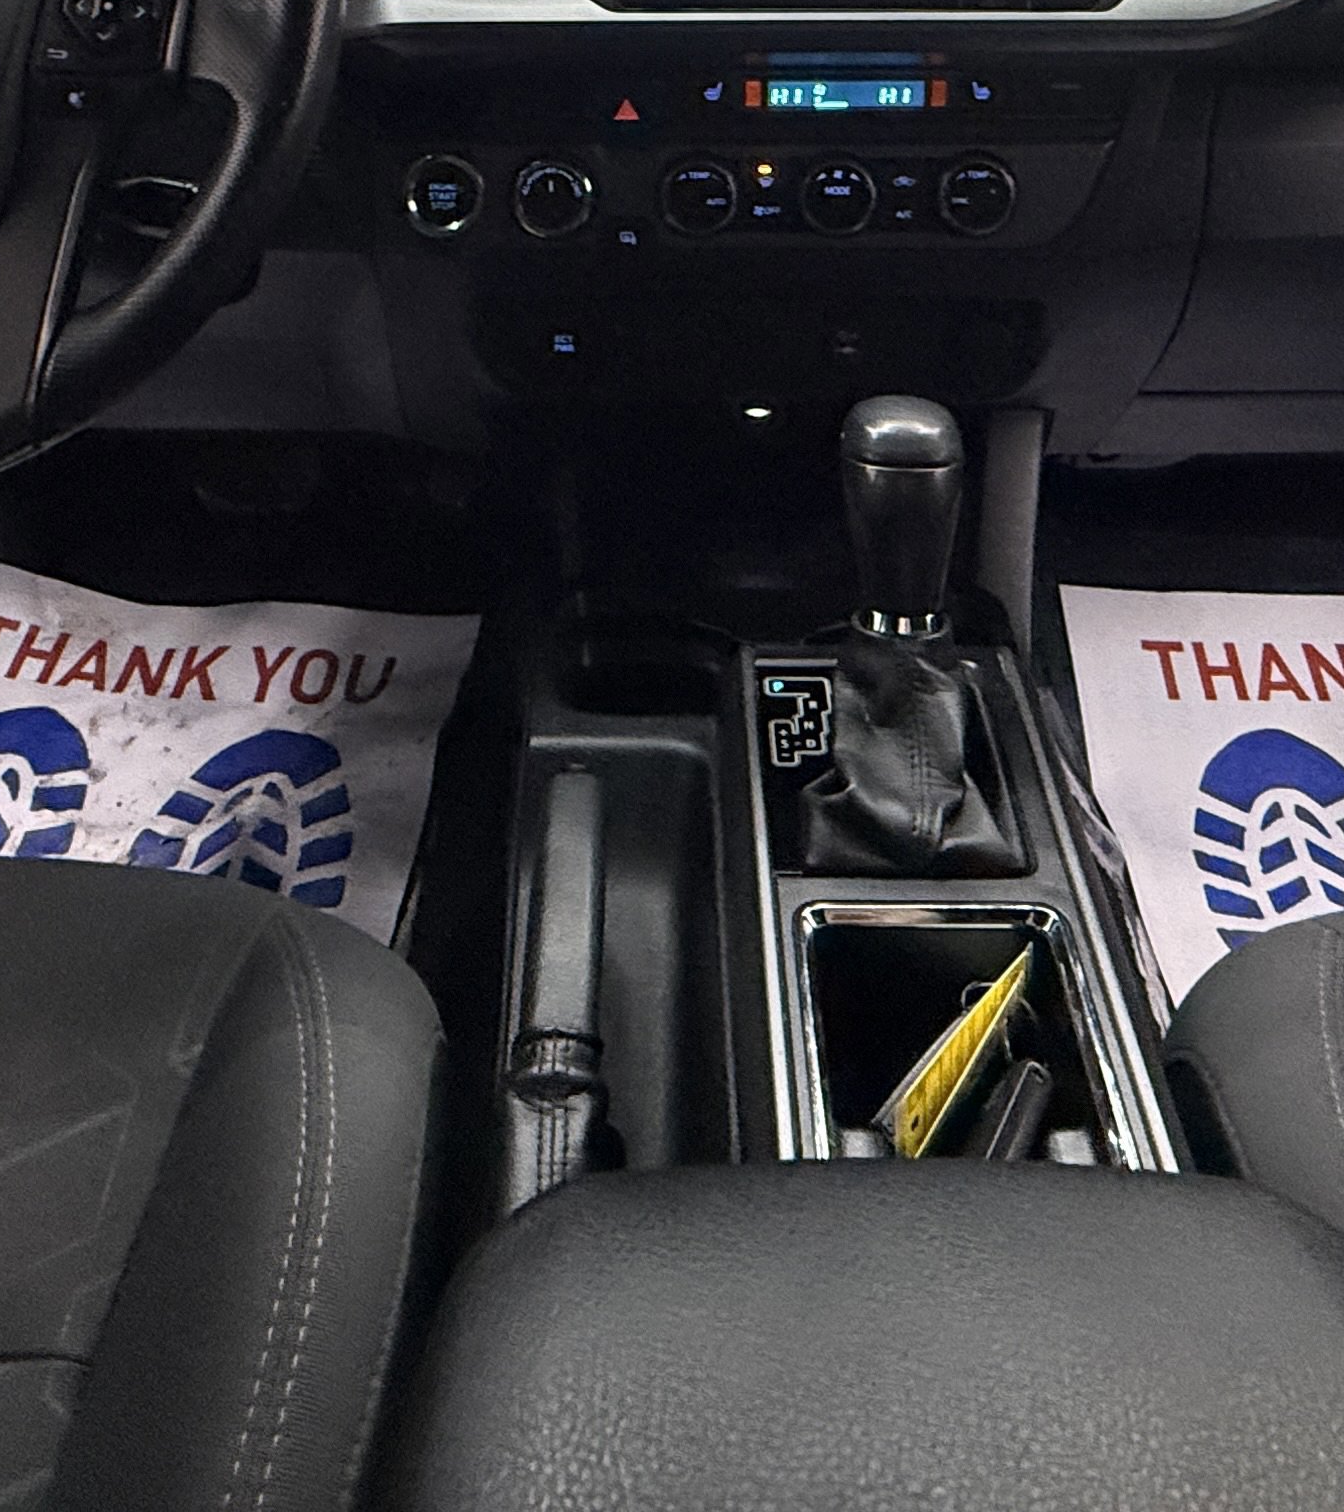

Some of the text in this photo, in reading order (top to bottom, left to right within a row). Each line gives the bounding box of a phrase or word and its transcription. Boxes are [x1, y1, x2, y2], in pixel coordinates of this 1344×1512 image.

[823, 185, 851, 196] MODE
[428, 191, 457, 201] START
[248, 646, 397, 706] YOU
[803, 720, 814, 730] N
